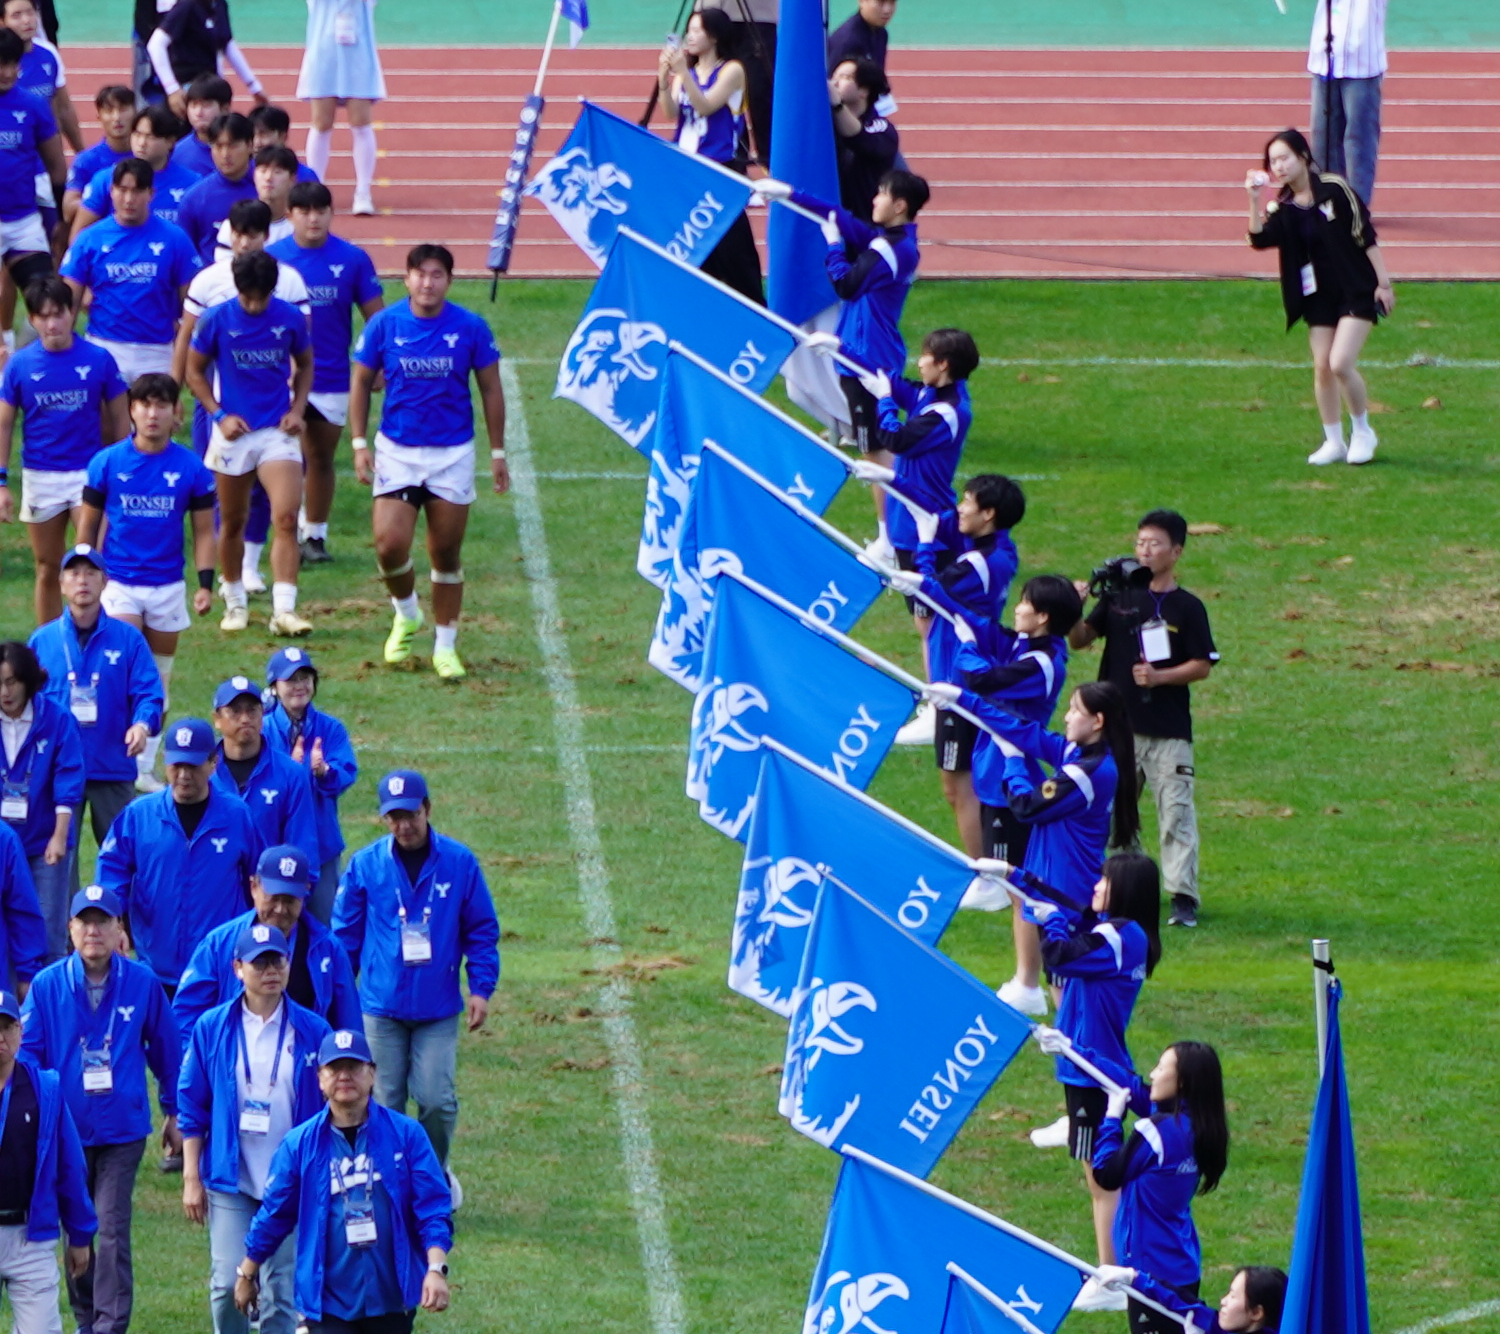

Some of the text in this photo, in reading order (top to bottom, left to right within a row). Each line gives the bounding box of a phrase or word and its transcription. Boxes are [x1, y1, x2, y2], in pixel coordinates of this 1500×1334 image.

[105, 262, 158, 278] YONSEI
[231, 349, 284, 365] YONSEI
[399, 356, 455, 373] YONSEI
[34, 389, 89, 407] YONSEI
[119, 493, 176, 510] YONSEI
